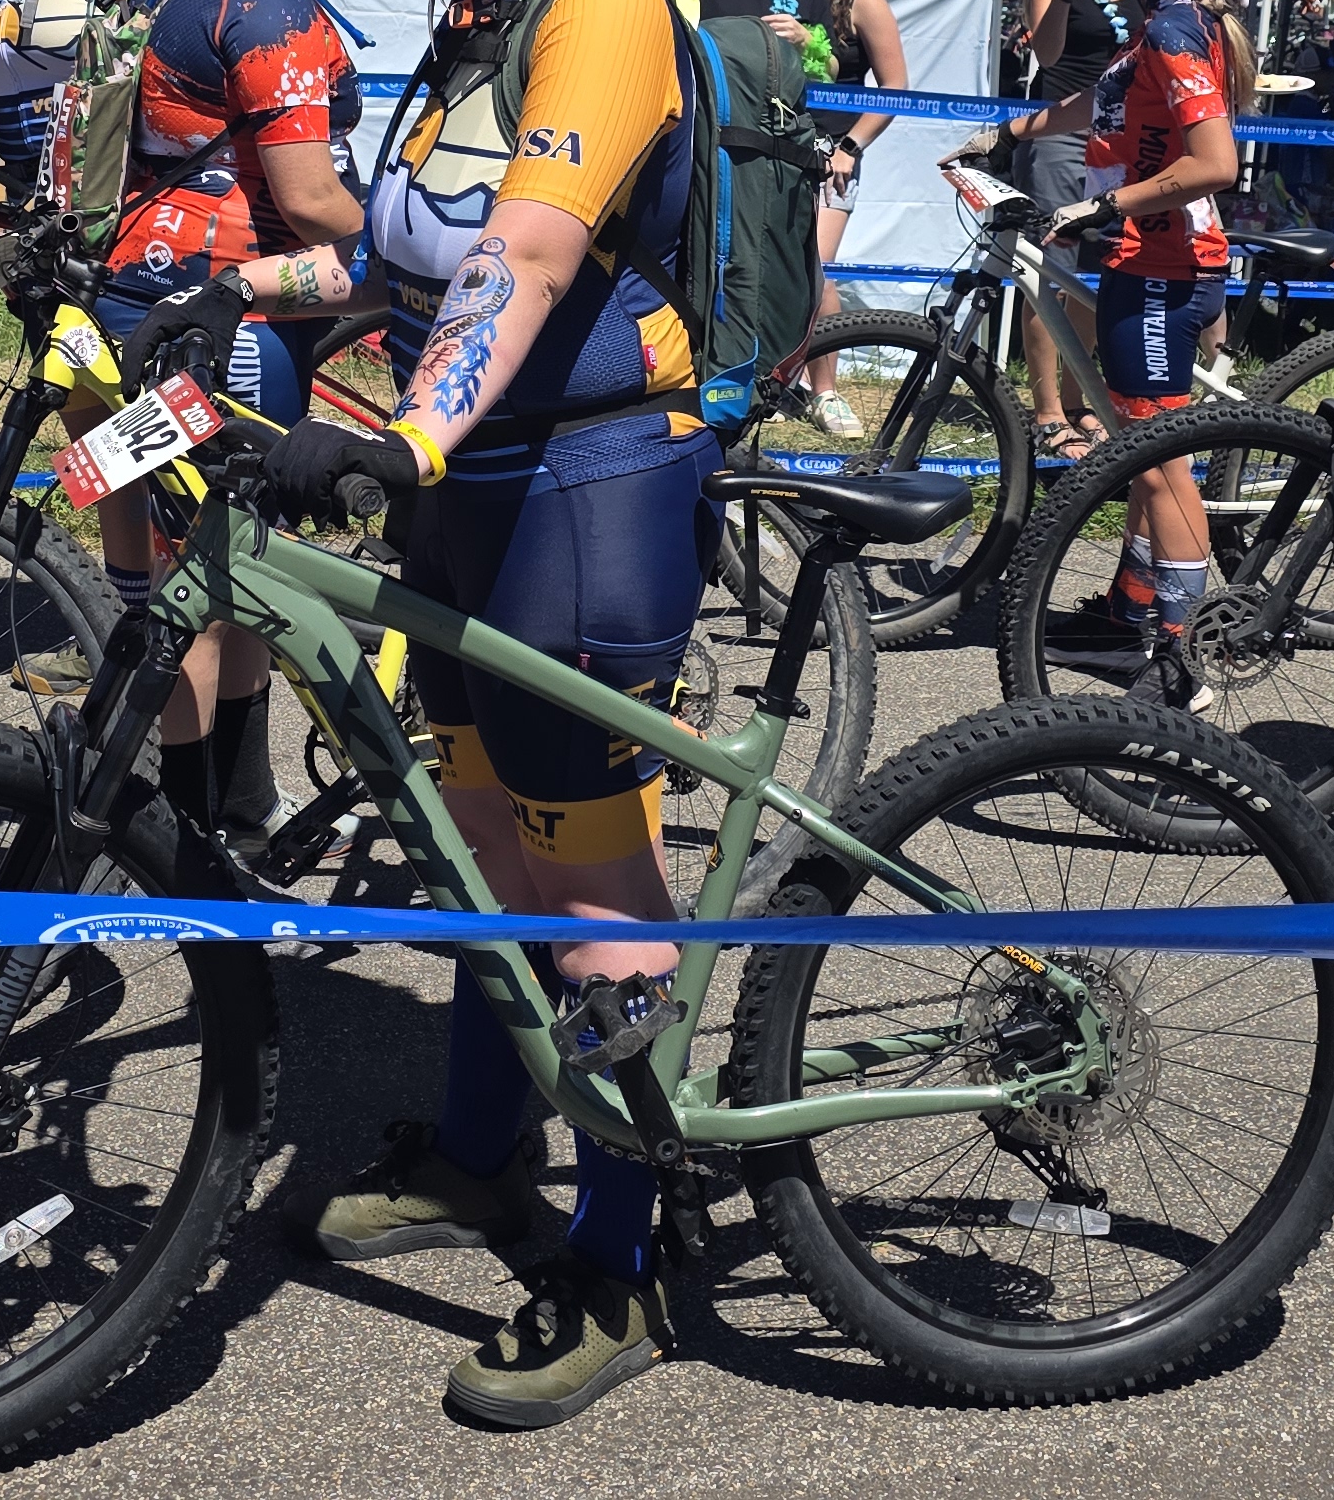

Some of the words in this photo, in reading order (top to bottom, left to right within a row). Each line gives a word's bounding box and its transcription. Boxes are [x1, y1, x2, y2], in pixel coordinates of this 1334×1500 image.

[814, 88, 940, 113] www.utahmtb.org
[1134, 124, 1171, 233] MUSS
[137, 269, 174, 287] MTNtek
[272, 260, 295, 316] BREATHE
[299, 259, 324, 308] DEEP
[398, 280, 445, 316] VOLT
[443, 310, 483, 339] POWER
[481, 290, 505, 316] OVER
[498, 275, 511, 293] ME
[64, 328, 83, 343] BLOOD
[1146, 298, 1169, 383] MOUNTAIN
[179, 401, 215, 437] 2026
[804, 460, 837, 472] UTAH
[1118, 740, 1272, 814] MAXXIS
[88, 918, 136, 931] LEAGUE
[138, 918, 192, 931] CYCLING
